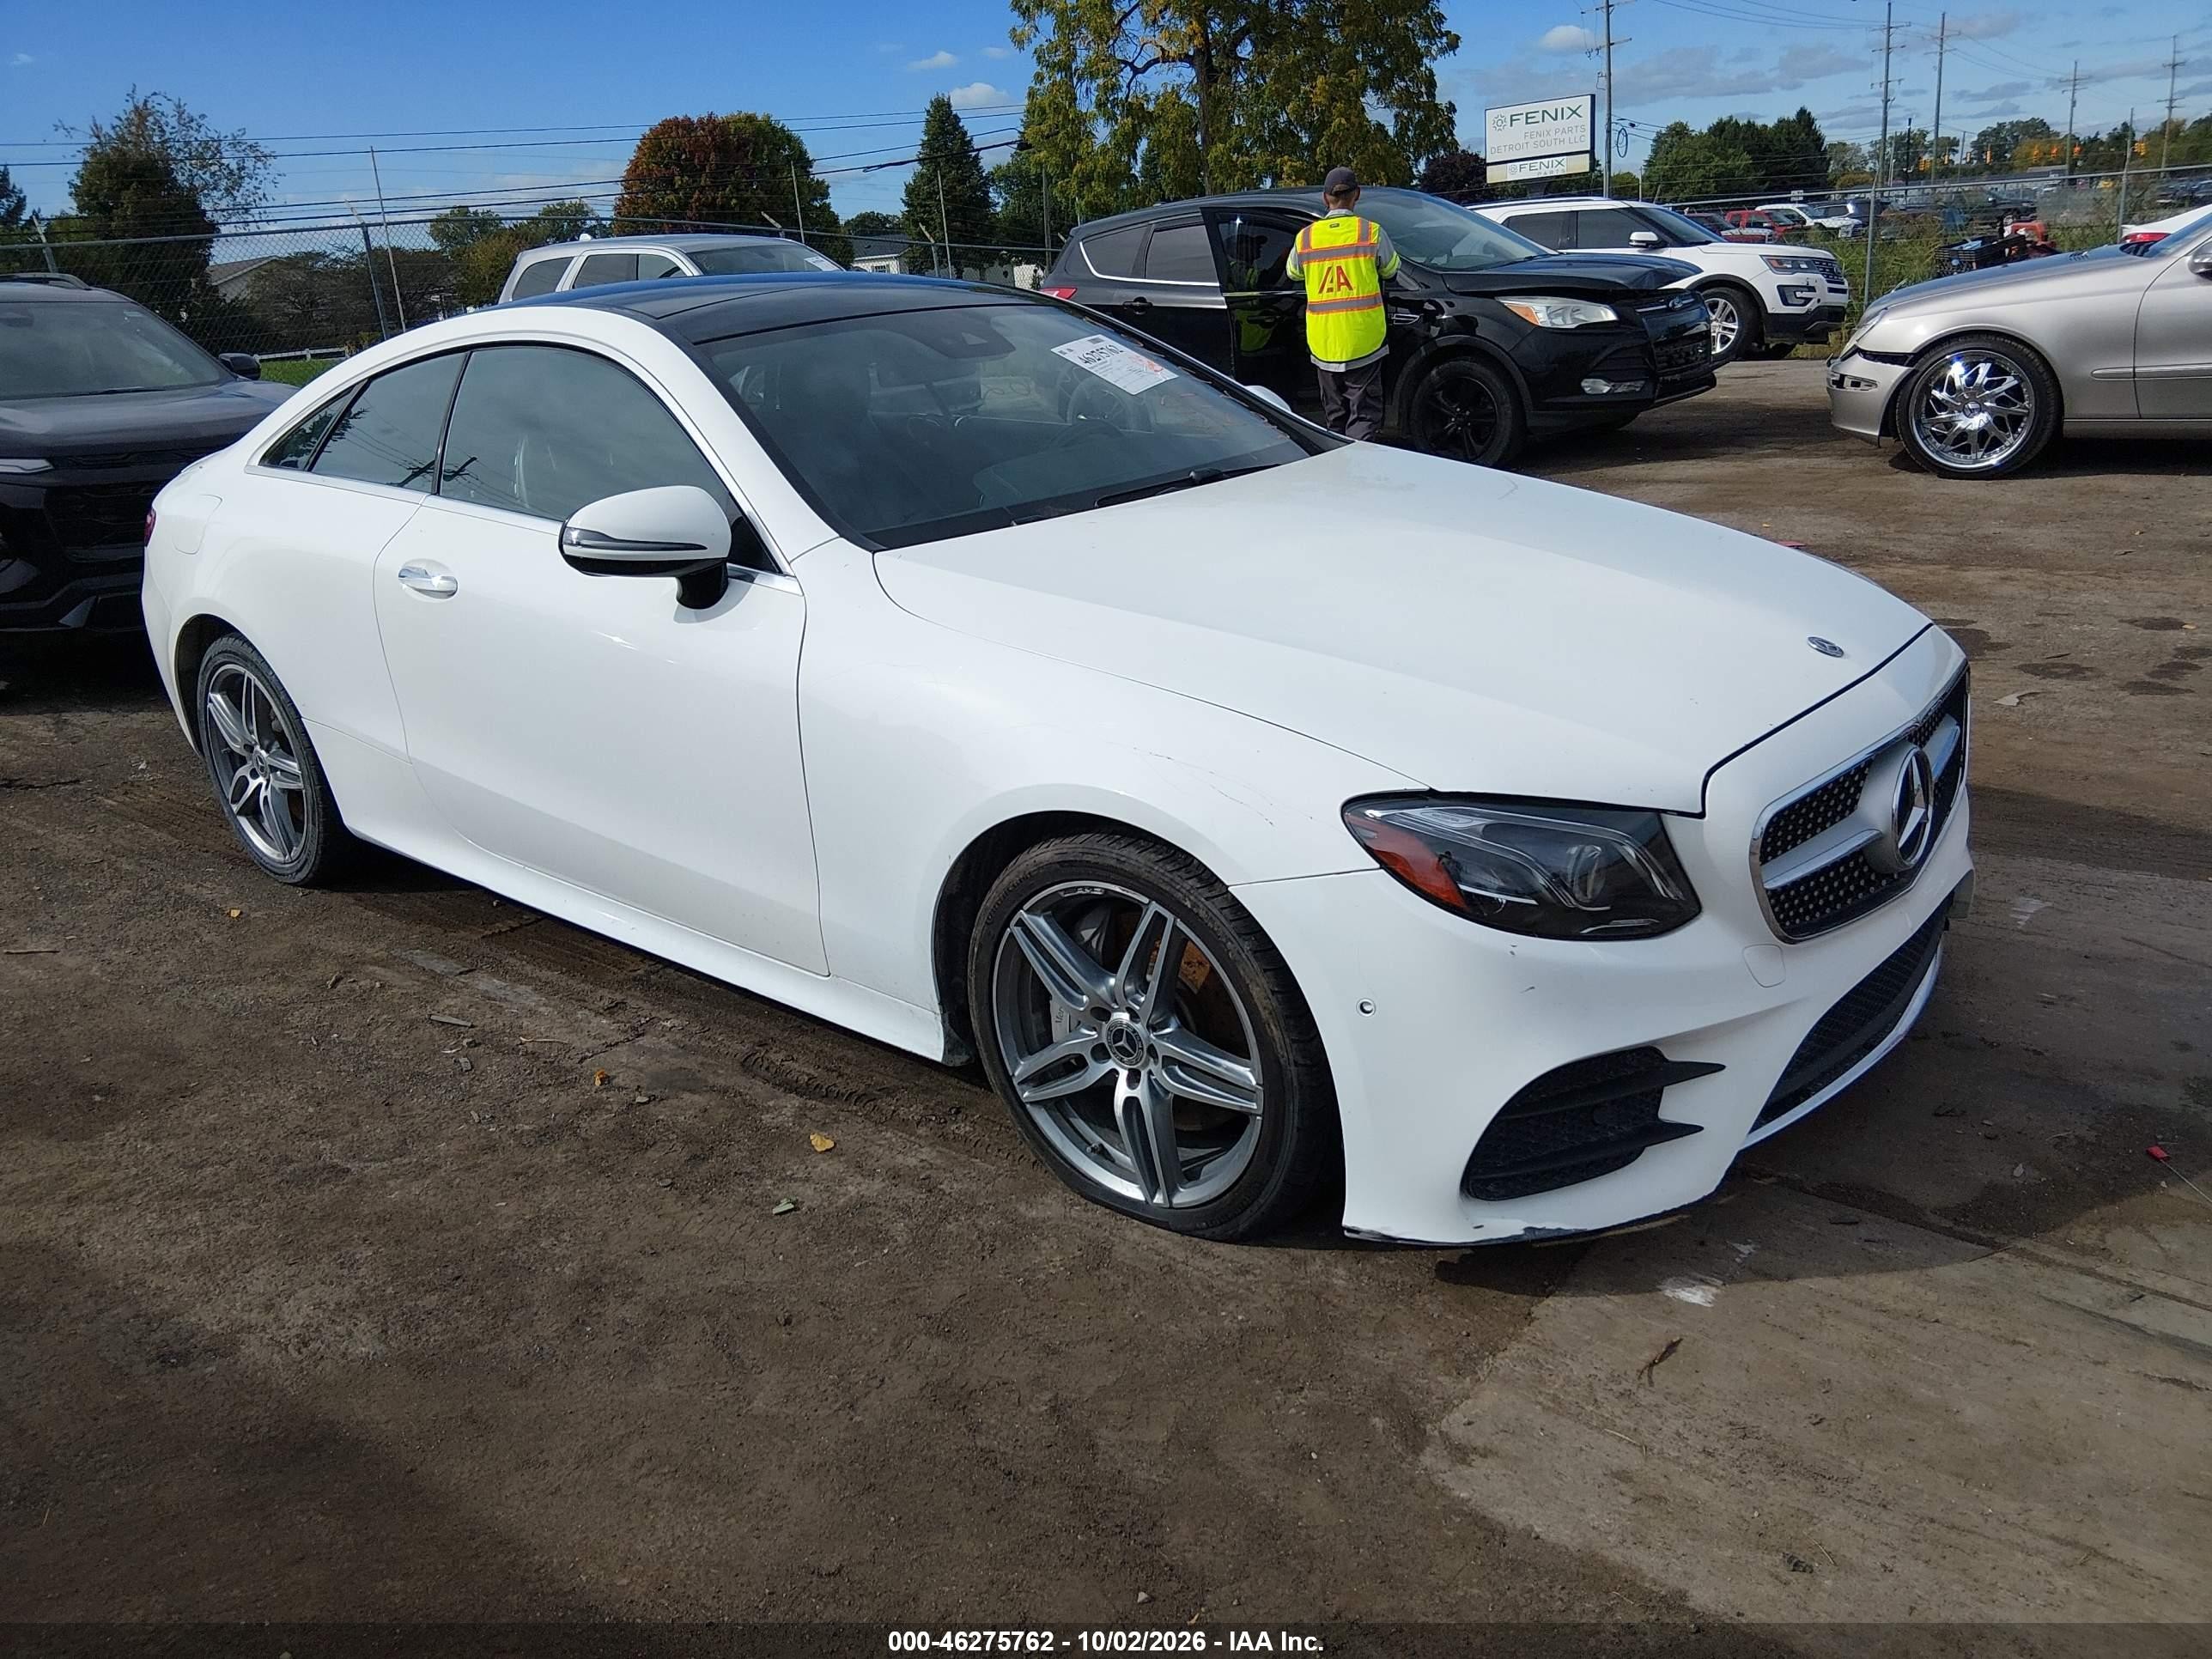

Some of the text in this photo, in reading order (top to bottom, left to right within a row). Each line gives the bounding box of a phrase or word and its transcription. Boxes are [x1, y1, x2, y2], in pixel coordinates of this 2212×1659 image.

[1510, 105, 1583, 127] FENIX
[1524, 125, 1586, 139] FENIX PARTS
[1490, 135, 1586, 155] DETROIT SOUTH LLC
[1519, 158, 1565, 173] FENIX
[1078, 344, 1124, 365] 46275762
